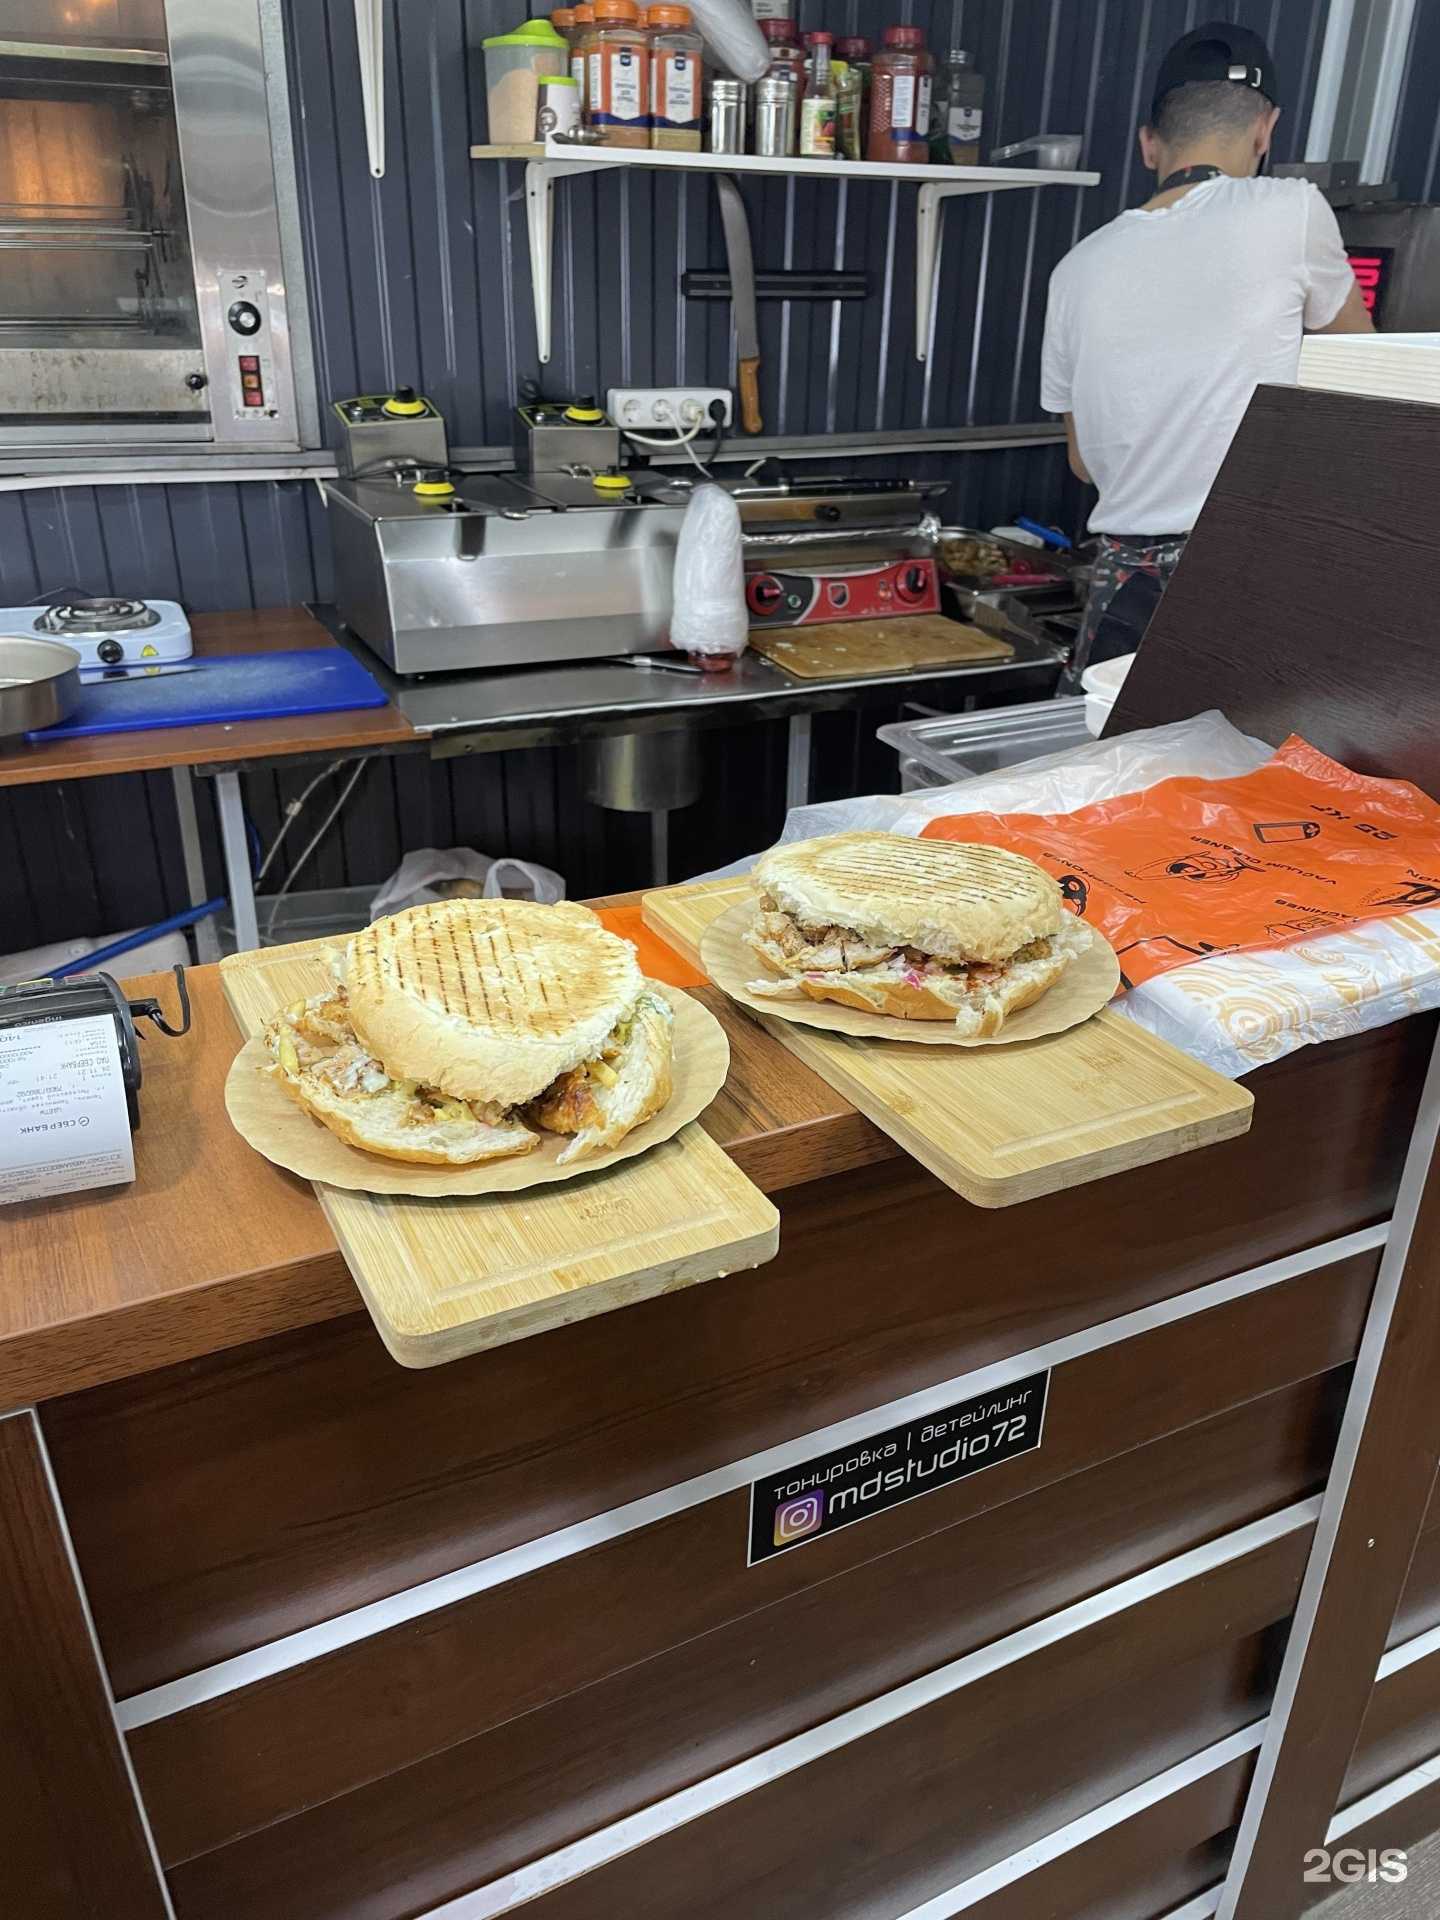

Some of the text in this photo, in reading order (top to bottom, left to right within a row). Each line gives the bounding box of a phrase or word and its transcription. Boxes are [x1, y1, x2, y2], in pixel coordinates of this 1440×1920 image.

[1353, 824, 1399, 841] 25
[1189, 836, 1337, 885] VACUUM CLEANER
[1274, 899, 1360, 922] ACHINES
[14, 1015, 62, 1028] ingenico
[774, 1391, 1032, 1500] тонировка детейлинг
[829, 1414, 1027, 1514] mdstudio72
